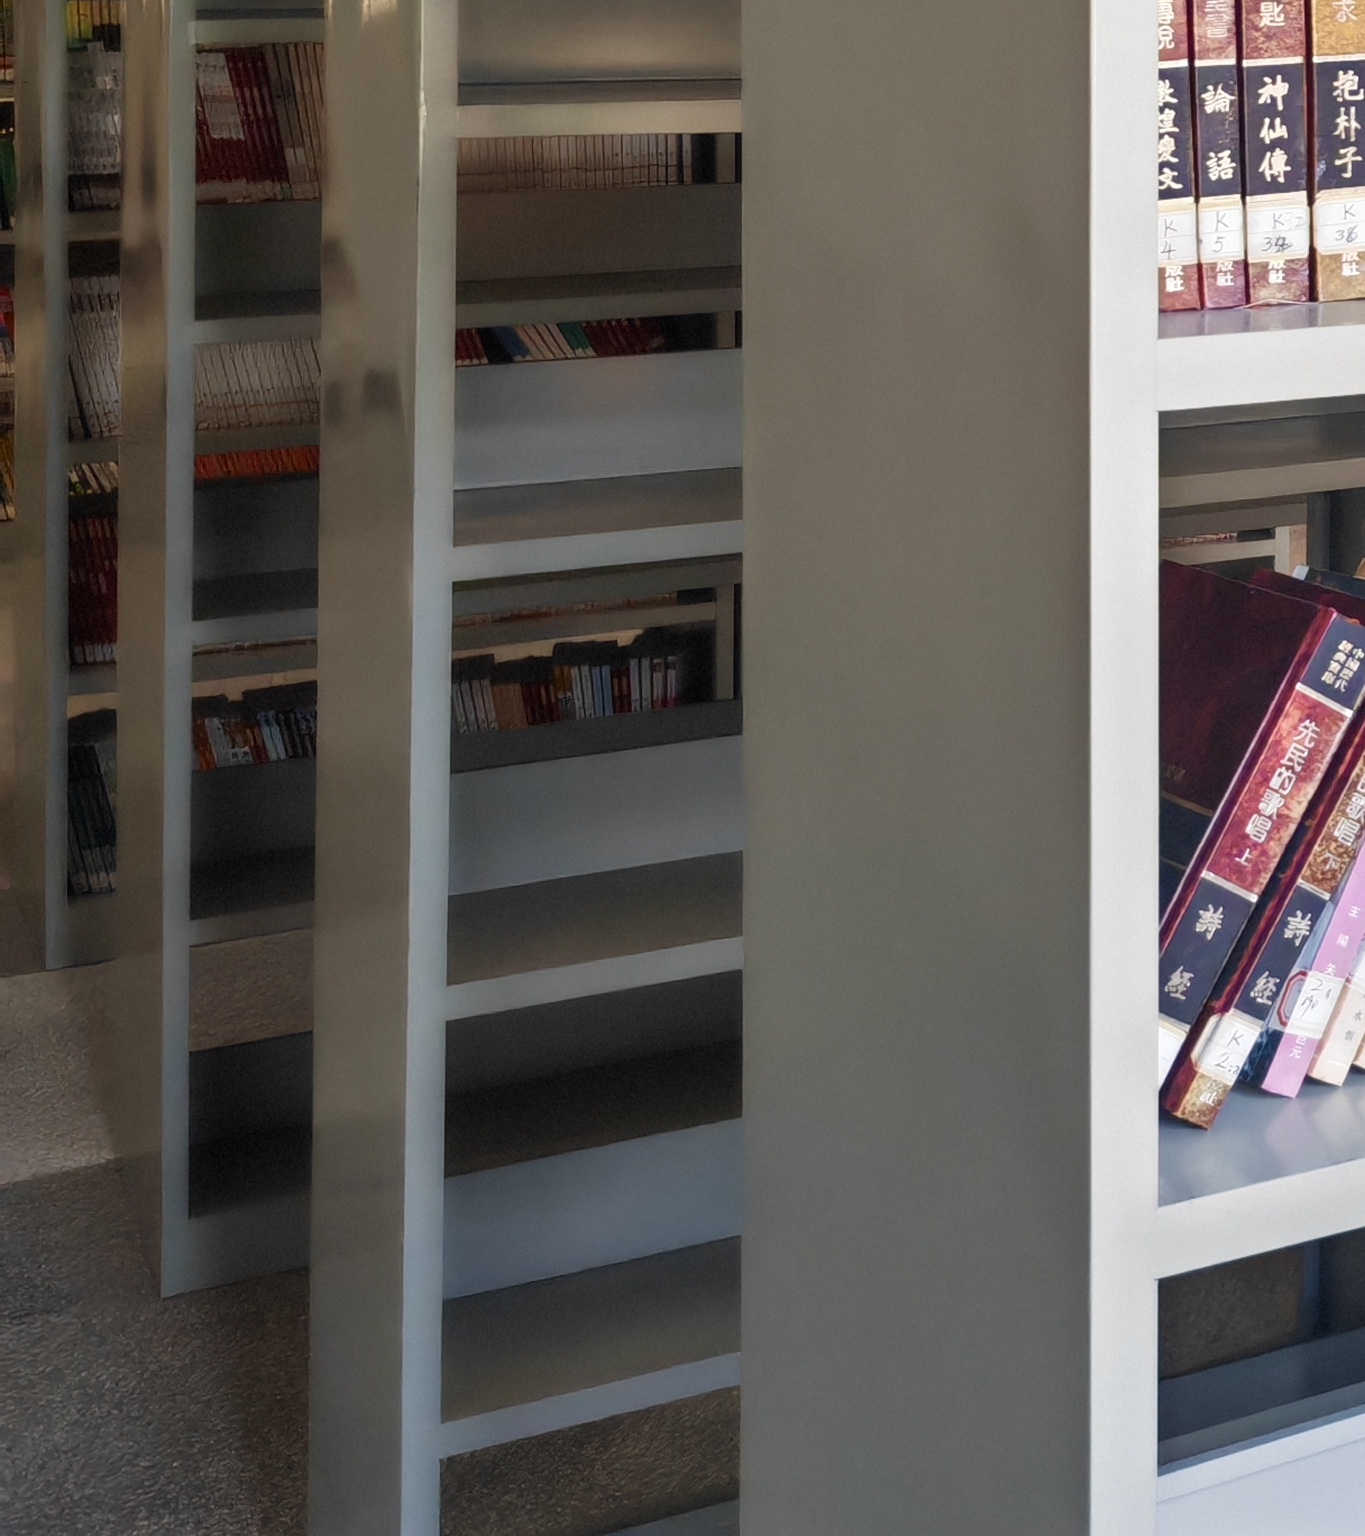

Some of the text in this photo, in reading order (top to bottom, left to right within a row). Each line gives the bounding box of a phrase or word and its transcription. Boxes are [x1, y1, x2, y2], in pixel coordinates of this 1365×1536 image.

[1202, 84, 1236, 181] 論語
[1258, 75, 1291, 183] 神仙傳
[1333, 70, 1365, 179] 抱朴子
[1235, 719, 1321, 867] 先民的歌唱 上
[1164, 905, 1224, 1000] 詩經
[1250, 910, 1312, 1005] 詩經
